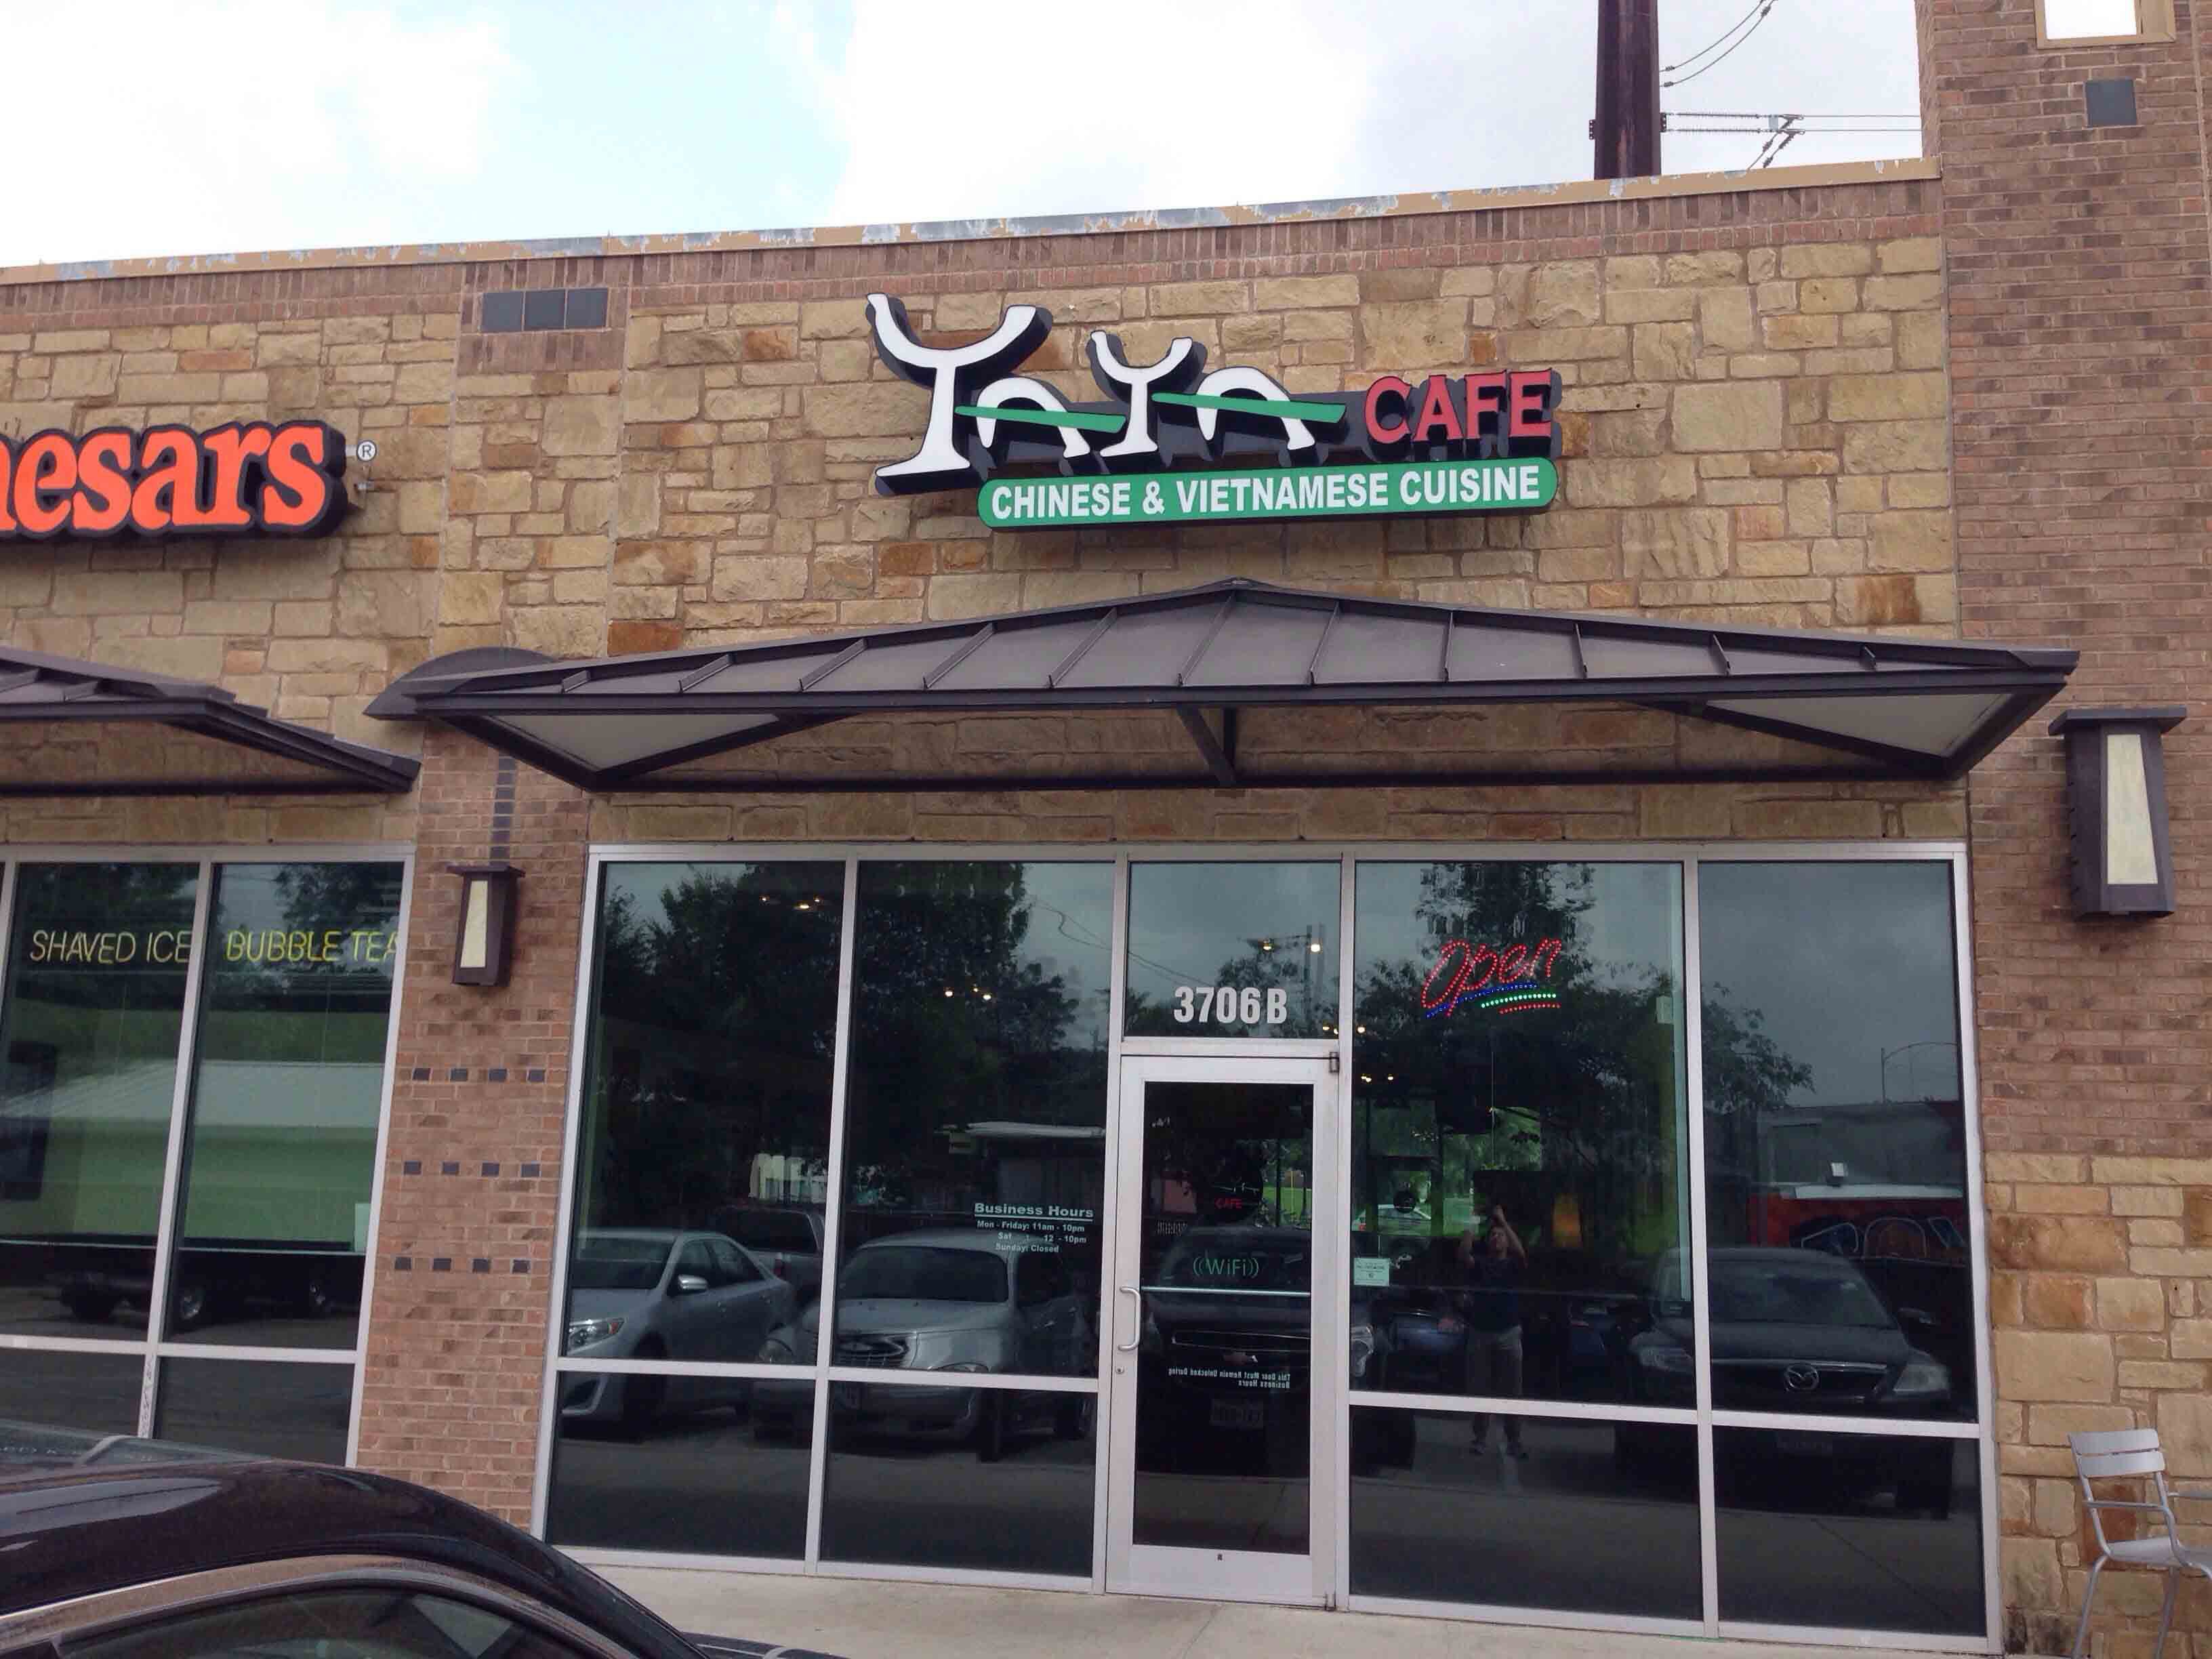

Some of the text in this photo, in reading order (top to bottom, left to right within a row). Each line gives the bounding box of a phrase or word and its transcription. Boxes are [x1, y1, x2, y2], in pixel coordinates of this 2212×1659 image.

[1365, 370, 1552, 443] CAFE
[0, 426, 327, 531] esars
[991, 466, 1540, 520] CHINESE & VIETNAMESE CUISINE
[30, 930, 192, 964] SHAVED ICE
[226, 931, 342, 962] BUBBLE
[1423, 938, 1563, 1018] Open
[975, 1203, 1094, 1218] Business Hours
[1002, 1221, 1029, 1231] Friday:
[1033, 1223, 1054, 1231] 11am
[1063, 1225, 1085, 1233] 10pm
[1065, 1235, 1086, 1244] 10pm
